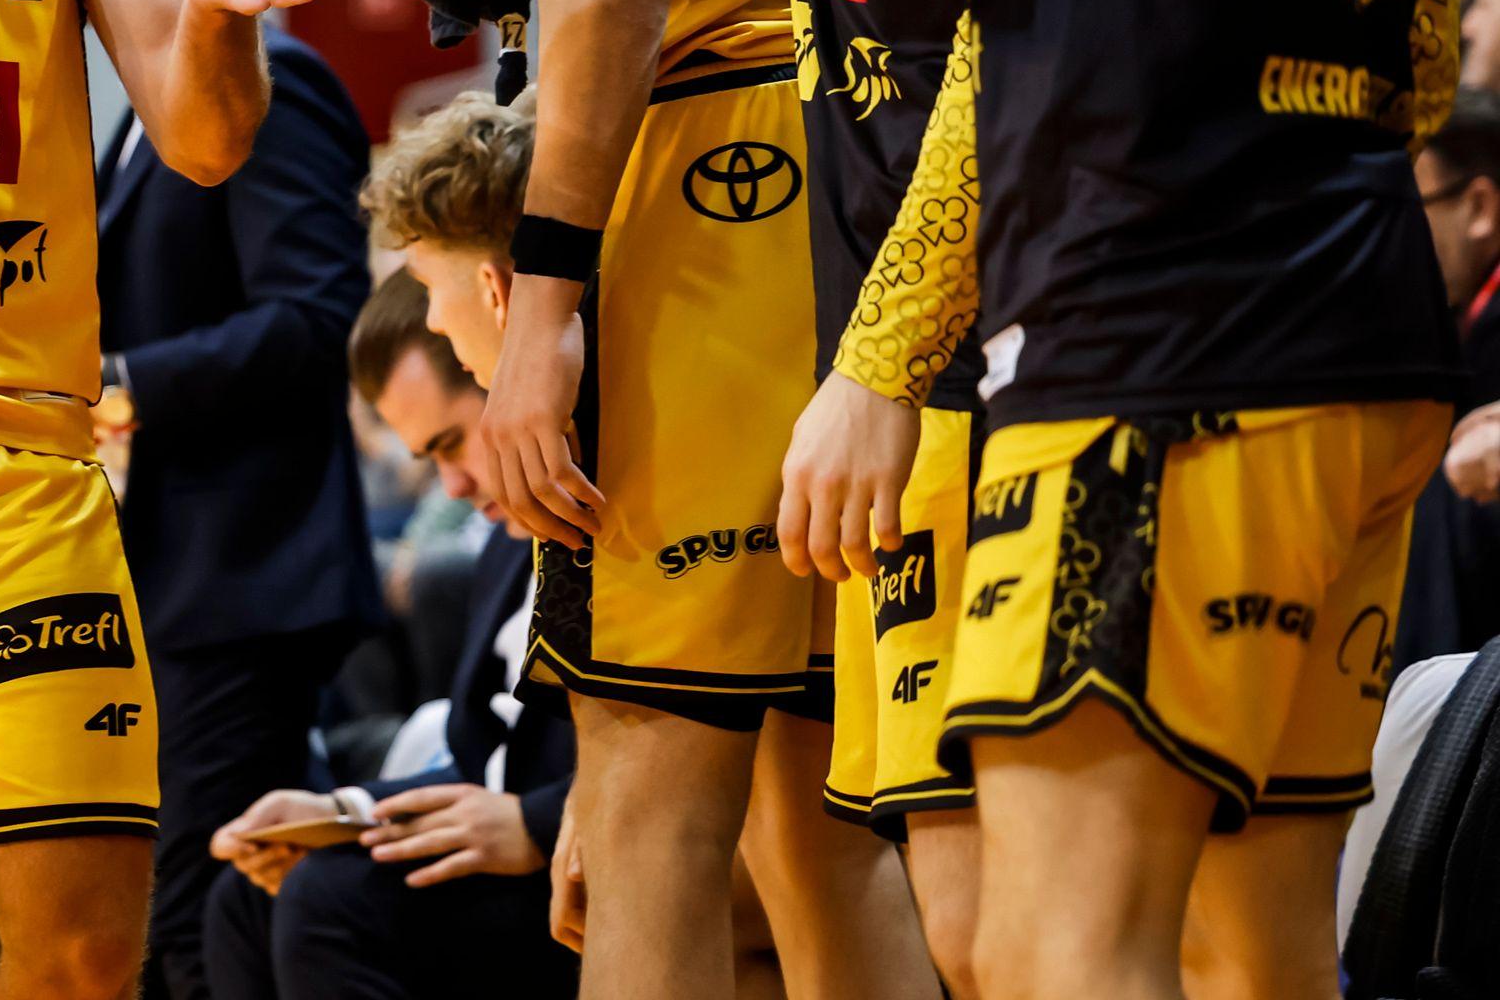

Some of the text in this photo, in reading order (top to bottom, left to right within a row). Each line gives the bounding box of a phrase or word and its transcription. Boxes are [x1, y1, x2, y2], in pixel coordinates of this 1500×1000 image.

[743, 523, 780, 555] GU
[31, 611, 121, 651] Trefl
[892, 659, 939, 704] 4F
[84, 702, 142, 737] 4F
